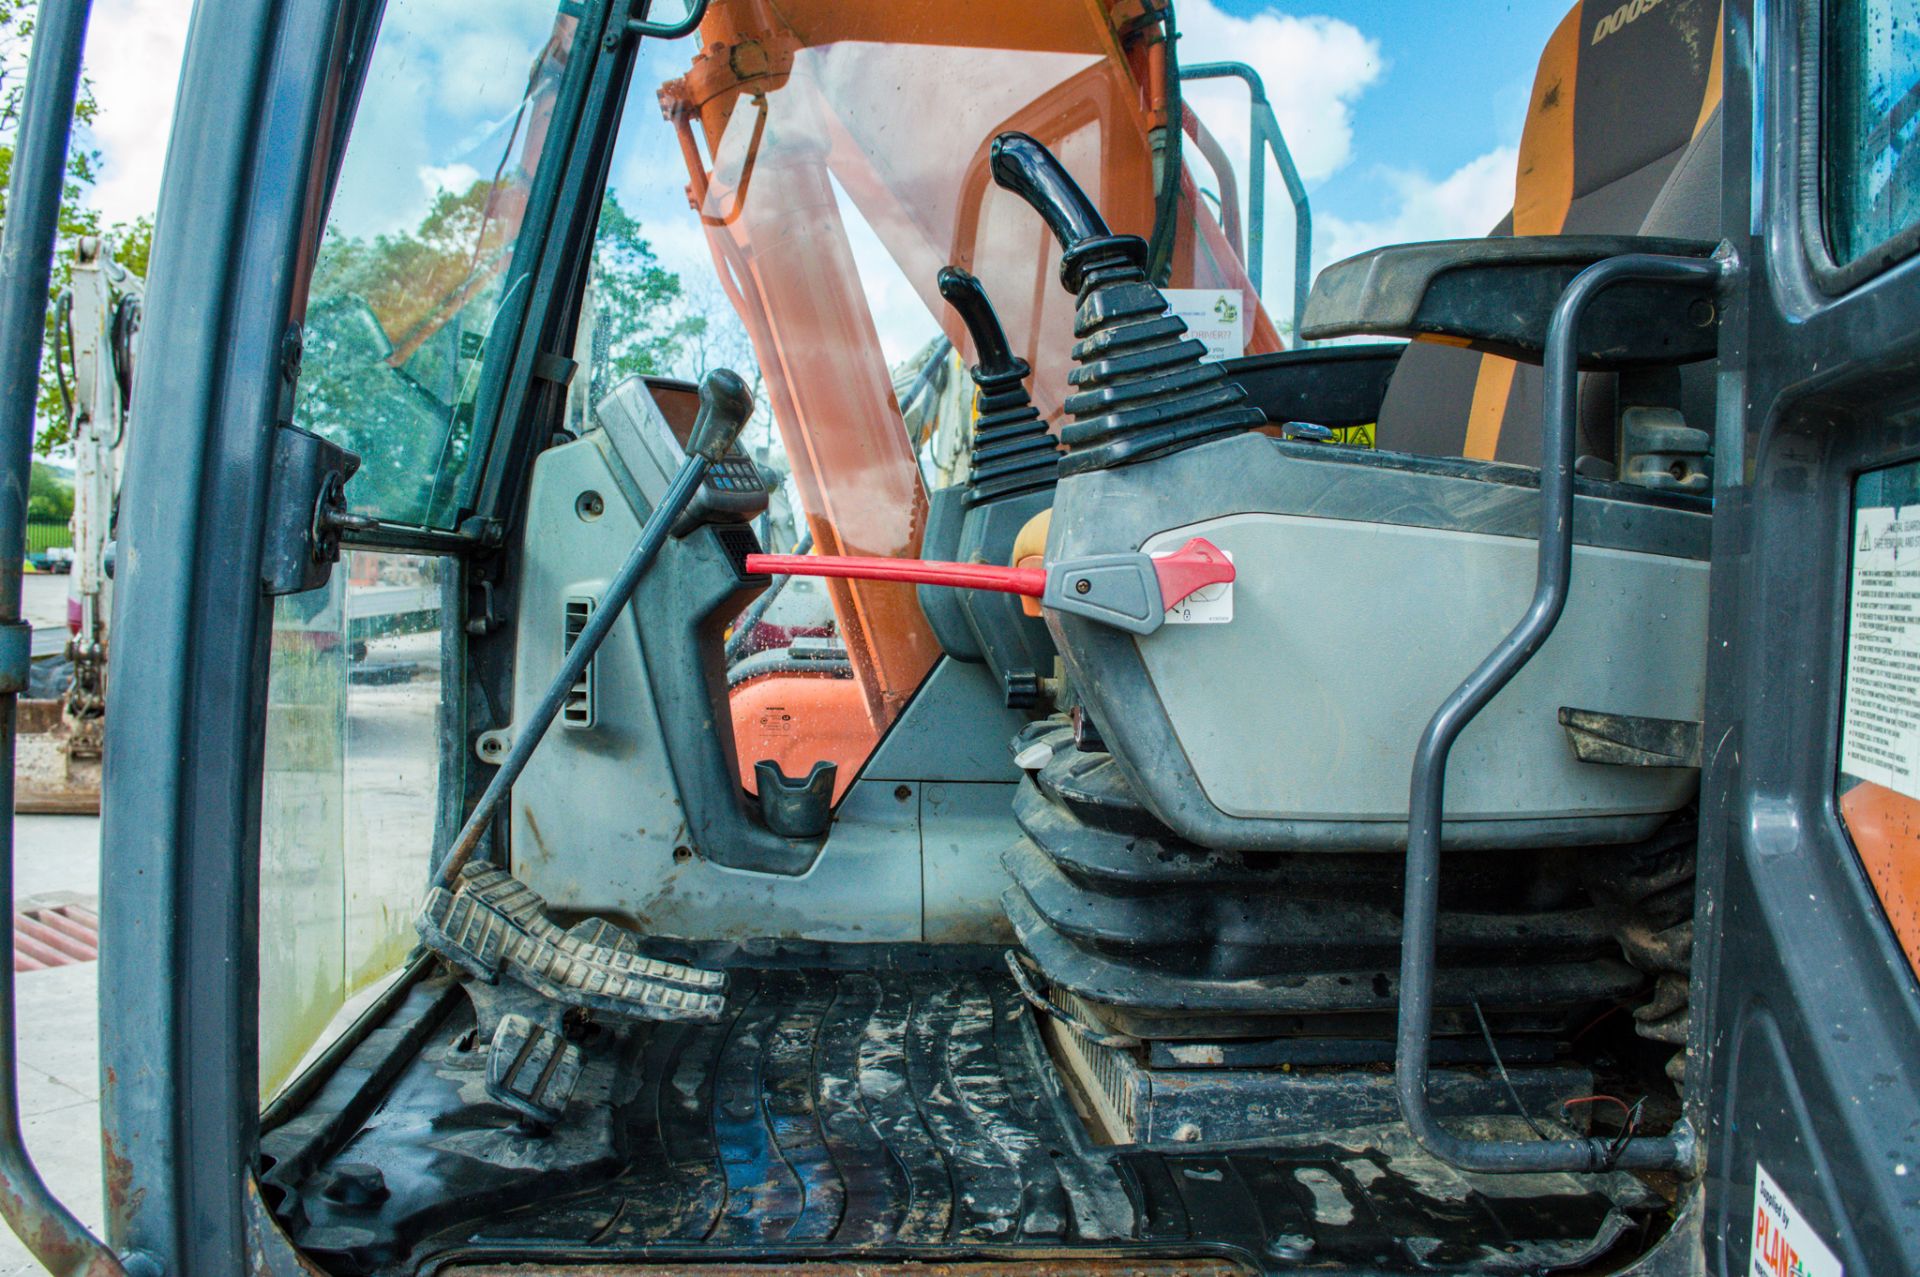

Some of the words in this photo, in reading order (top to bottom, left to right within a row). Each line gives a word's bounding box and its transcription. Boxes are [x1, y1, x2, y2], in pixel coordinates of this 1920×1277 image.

[1591, 0, 1663, 45] DOOS
[1760, 1180, 1782, 1217] Supplied
[1782, 1208, 1789, 1230] by
